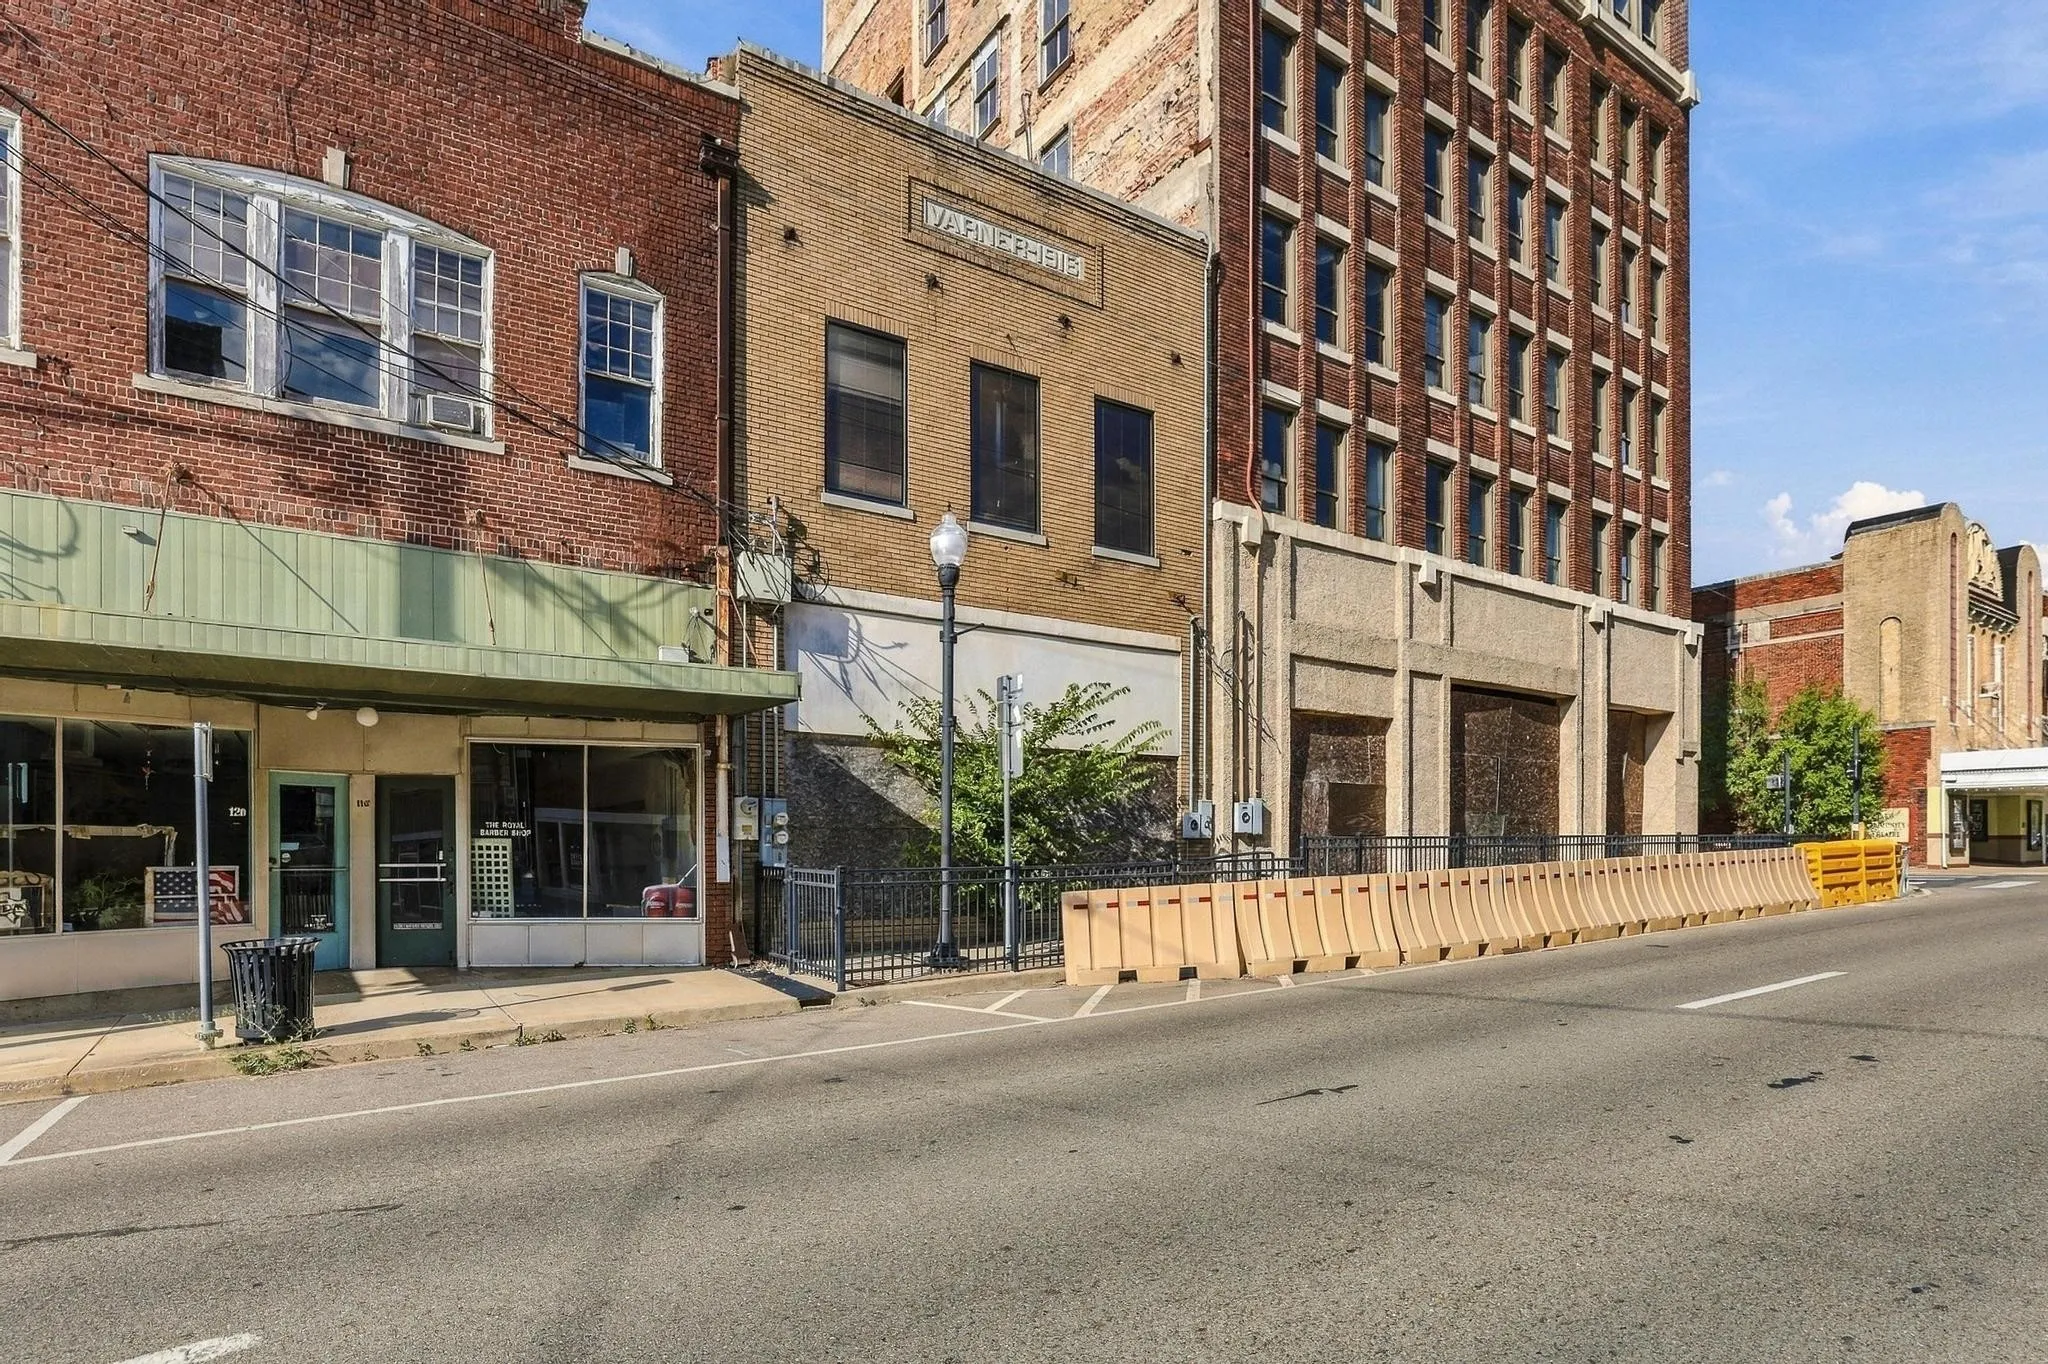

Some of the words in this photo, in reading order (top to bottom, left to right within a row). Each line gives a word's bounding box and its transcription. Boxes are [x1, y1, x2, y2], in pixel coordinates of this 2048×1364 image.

[485, 821, 500, 829] THE
[502, 821, 525, 829] ROYAL
[480, 829, 509, 837] BARBER
[511, 829, 532, 837] SHOP
